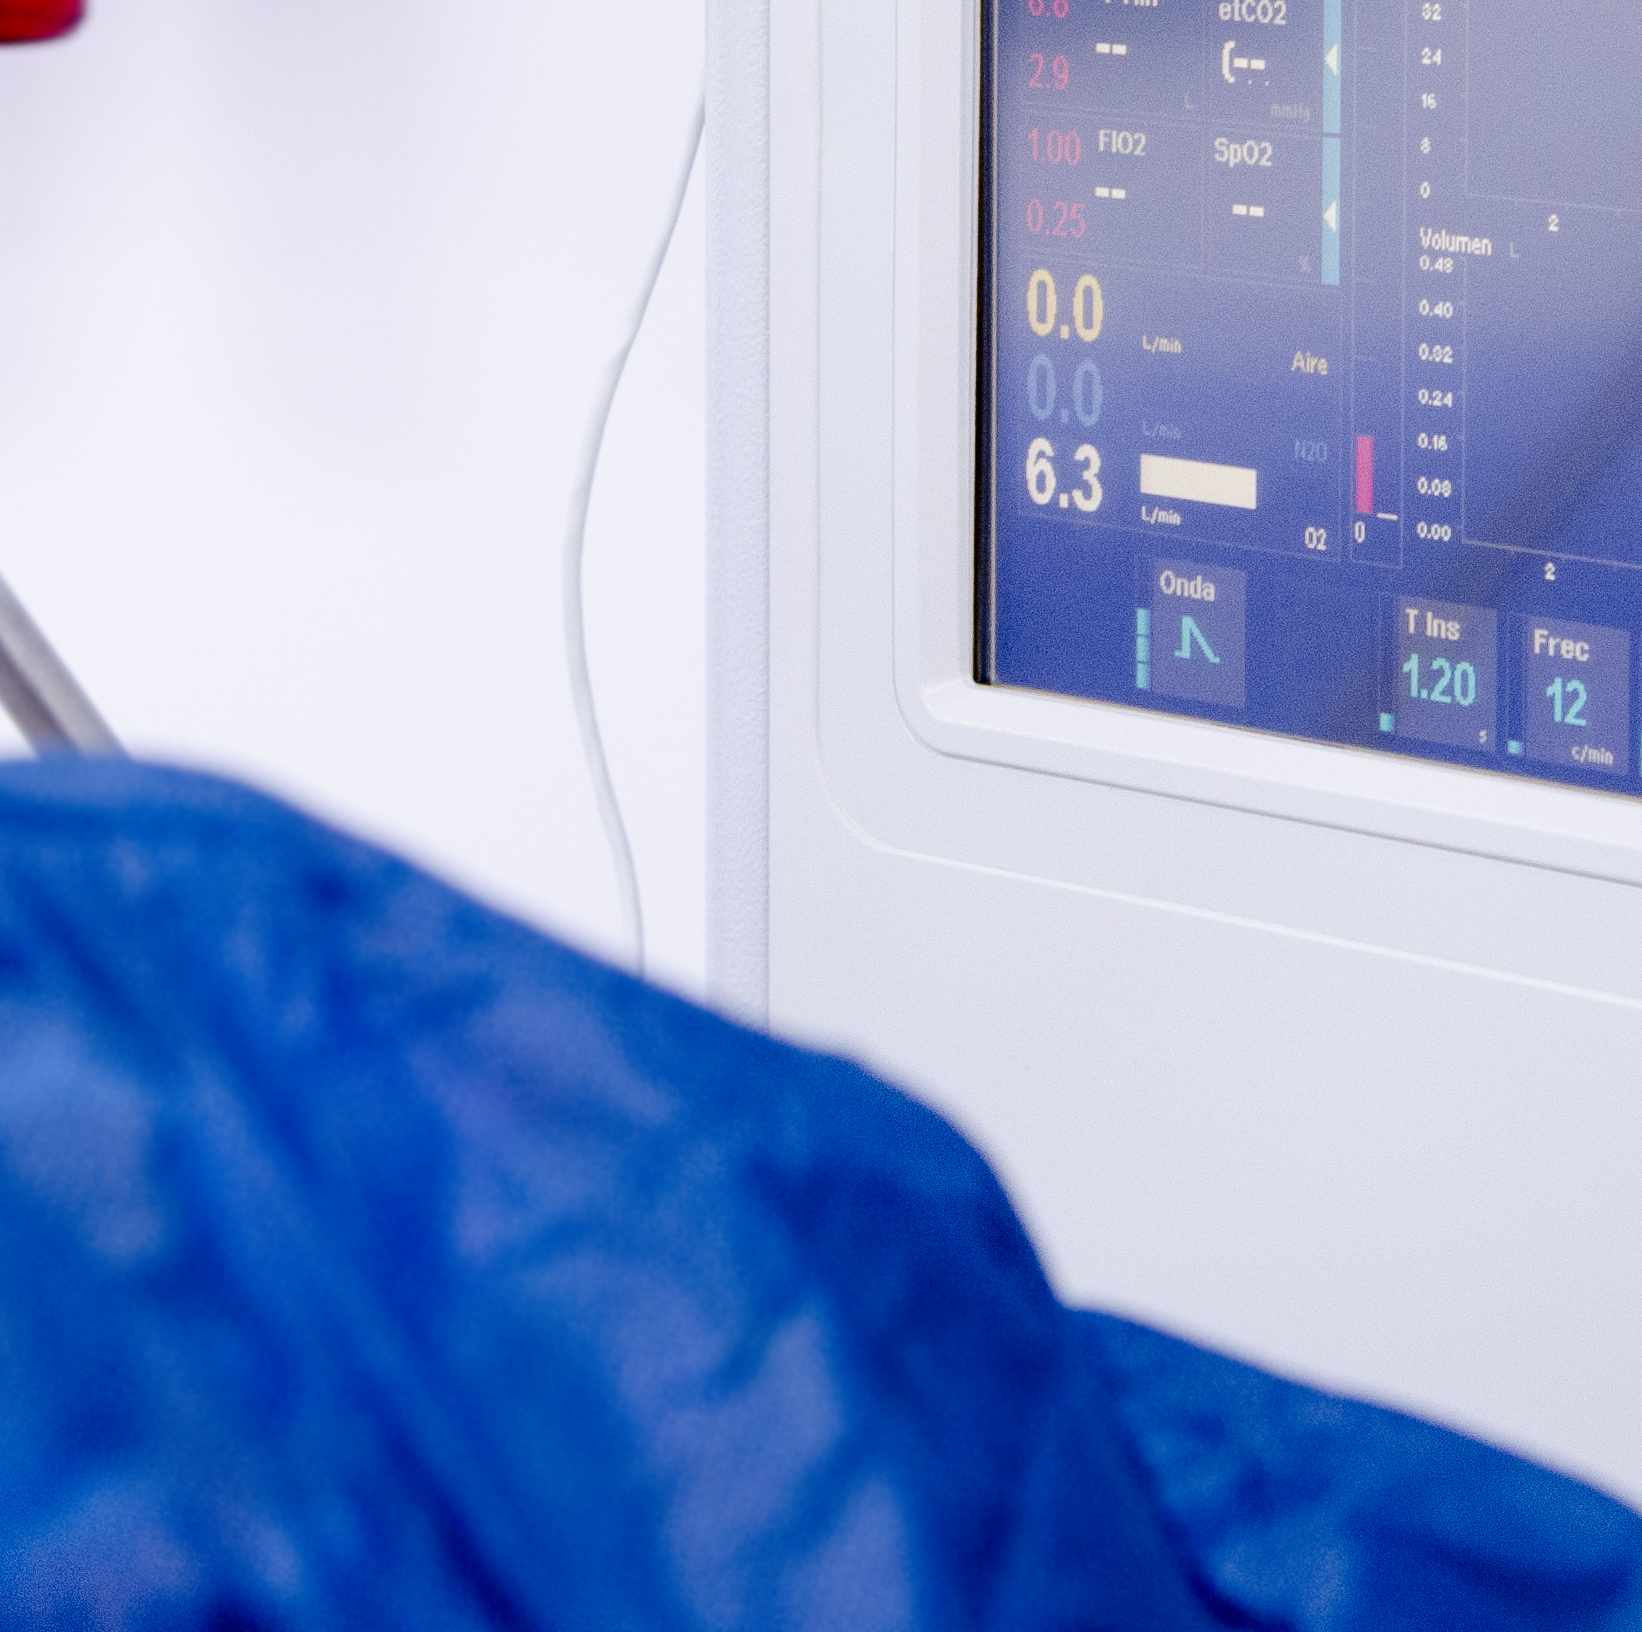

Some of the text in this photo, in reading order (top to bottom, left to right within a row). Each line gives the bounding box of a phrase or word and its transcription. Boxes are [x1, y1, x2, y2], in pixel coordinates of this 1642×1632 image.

[1421, 47, 1442, 66] 24
[1029, 53, 1069, 91] 2.9
[1028, 128, 1082, 166] 1.00
[1214, 138, 1272, 167] SpO2
[1420, 181, 1431, 199] 0
[1026, 199, 1086, 238] 0.25
[1548, 213, 1559, 232] 2
[1420, 226, 1492, 256] Volumen
[1026, 268, 1104, 342] 0.0
[1418, 298, 1453, 319] 0.40
[1142, 335, 1182, 354] L/min
[1290, 351, 1328, 375] Aire
[1026, 353, 1103, 428] 0.0
[1418, 388, 1453, 408] 0.24
[1026, 437, 1103, 512] 6.3
[1141, 506, 1181, 526] L/min
[1355, 521, 1365, 543] 0
[1416, 521, 1452, 542] 0.00
[1160, 570, 1215, 602] Onda
[1544, 562, 1556, 581] 2
[1406, 608, 1460, 641] T Ins
[1534, 628, 1590, 661] Frec
[1402, 653, 1476, 707] 1.20
[1546, 677, 1587, 727] 12
[1572, 743, 1614, 766] c/min
